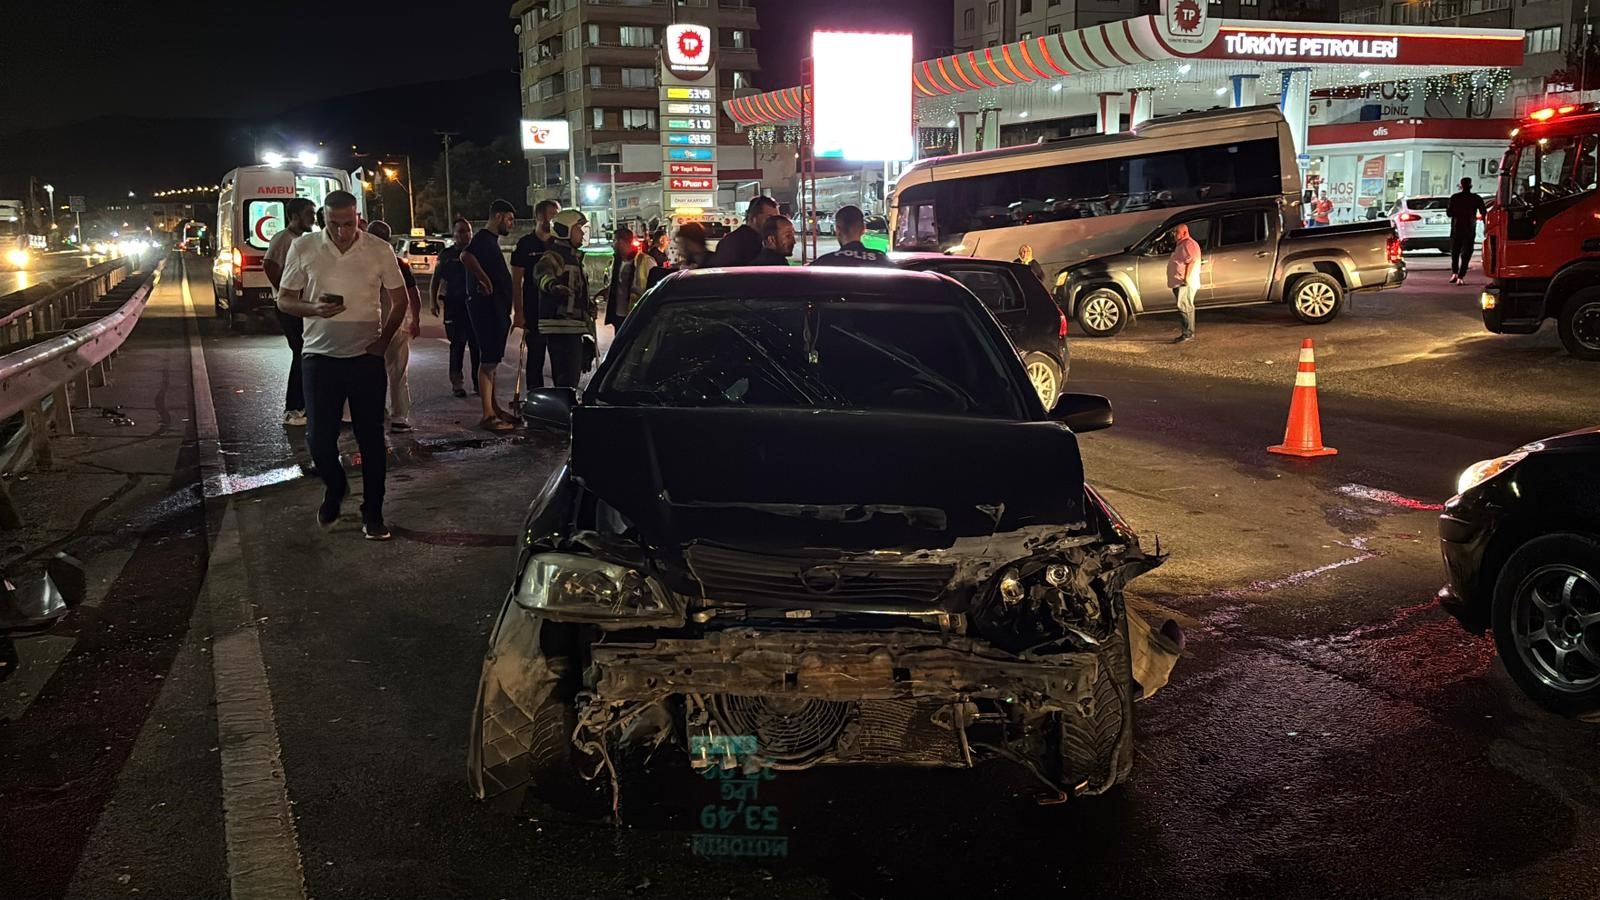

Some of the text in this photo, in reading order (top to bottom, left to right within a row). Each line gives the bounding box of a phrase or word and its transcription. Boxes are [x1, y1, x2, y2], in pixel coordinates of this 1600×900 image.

[1182, 10, 1196, 21] TP
[683, 38, 699, 51] TP
[1225, 33, 1398, 59] TÜRKİYE PETROLLERİ
[1372, 127, 1389, 136] ofis
[257, 186, 294, 195] AMBU
